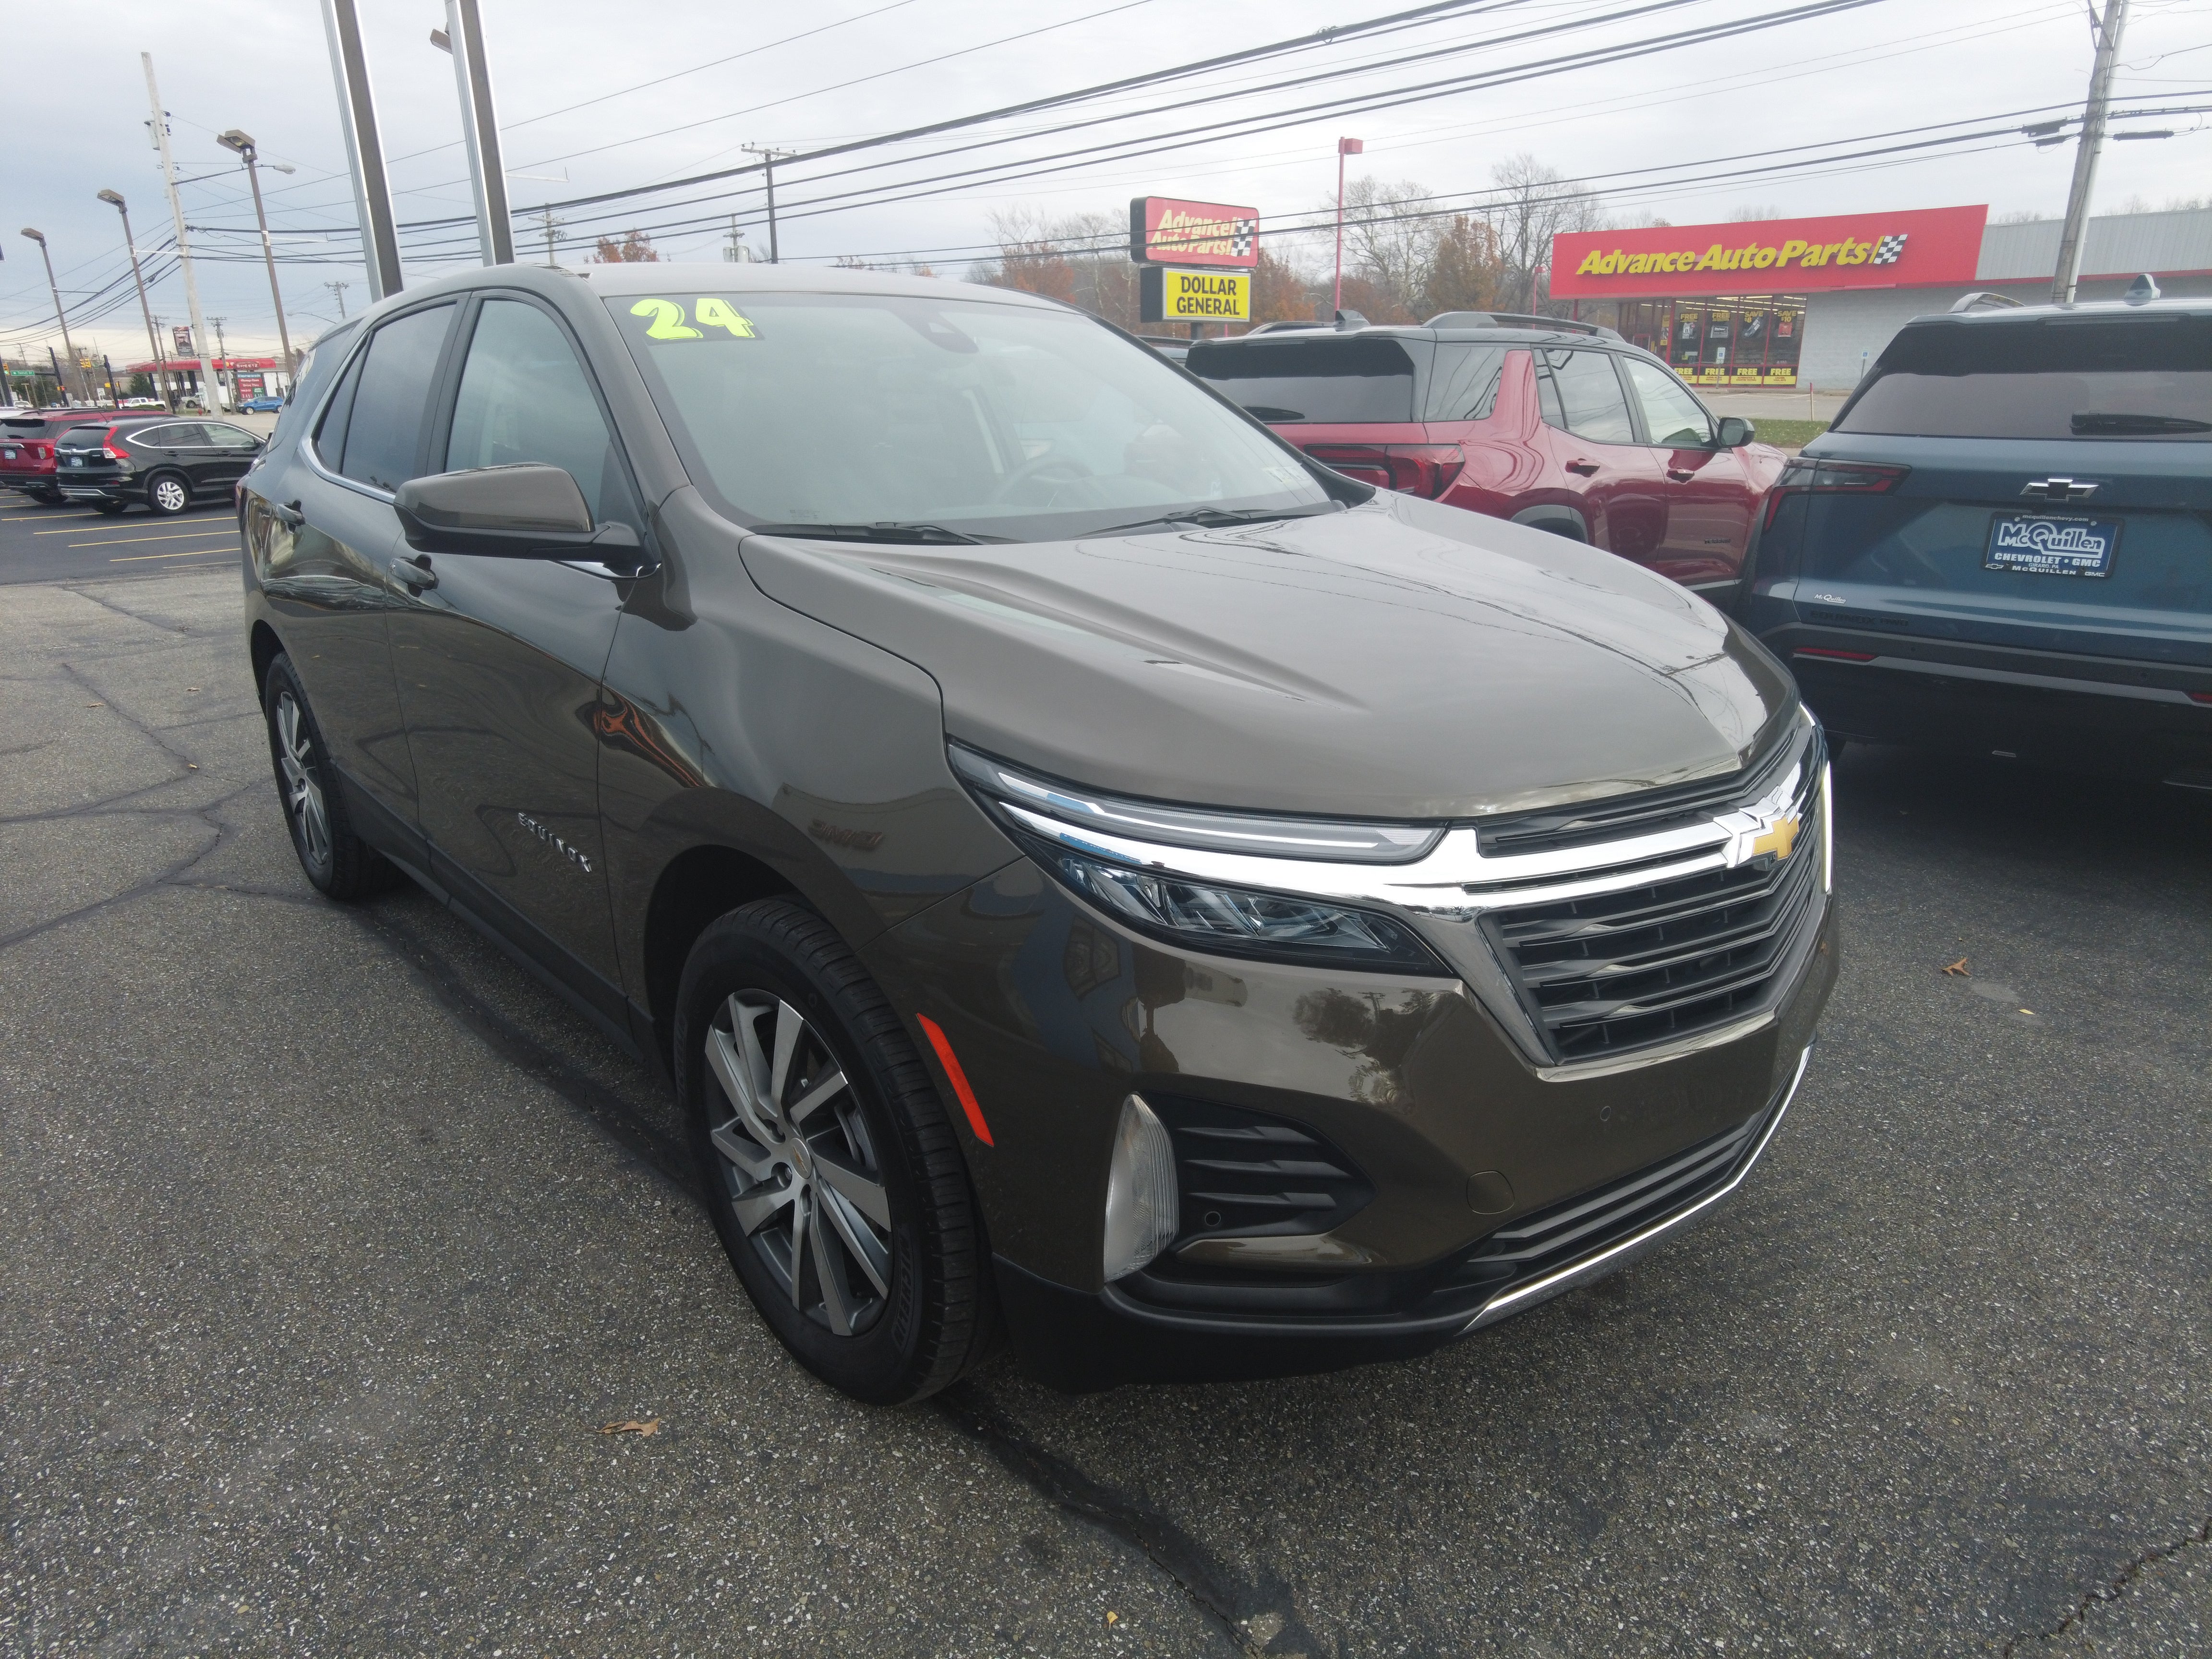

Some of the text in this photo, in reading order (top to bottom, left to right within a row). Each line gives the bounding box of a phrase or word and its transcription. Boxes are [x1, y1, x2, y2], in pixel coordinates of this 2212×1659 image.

[1157, 209, 1231, 236] Advance
[1149, 232, 1224, 255] Auto Parts
[1575, 237, 1873, 275] Advance Auto Parts
[1180, 276, 1237, 296] DOLLAR
[630, 298, 756, 340] 24
[1177, 296, 1240, 315] GENERAL
[1997, 522, 2105, 558] McQuillen
[1994, 553, 2101, 567] CHEVROLET GMC
[1814, 594, 1847, 604] McQuillen
[518, 812, 592, 873] EQUINOX
[893, 1233, 912, 1347] MICHELIN
